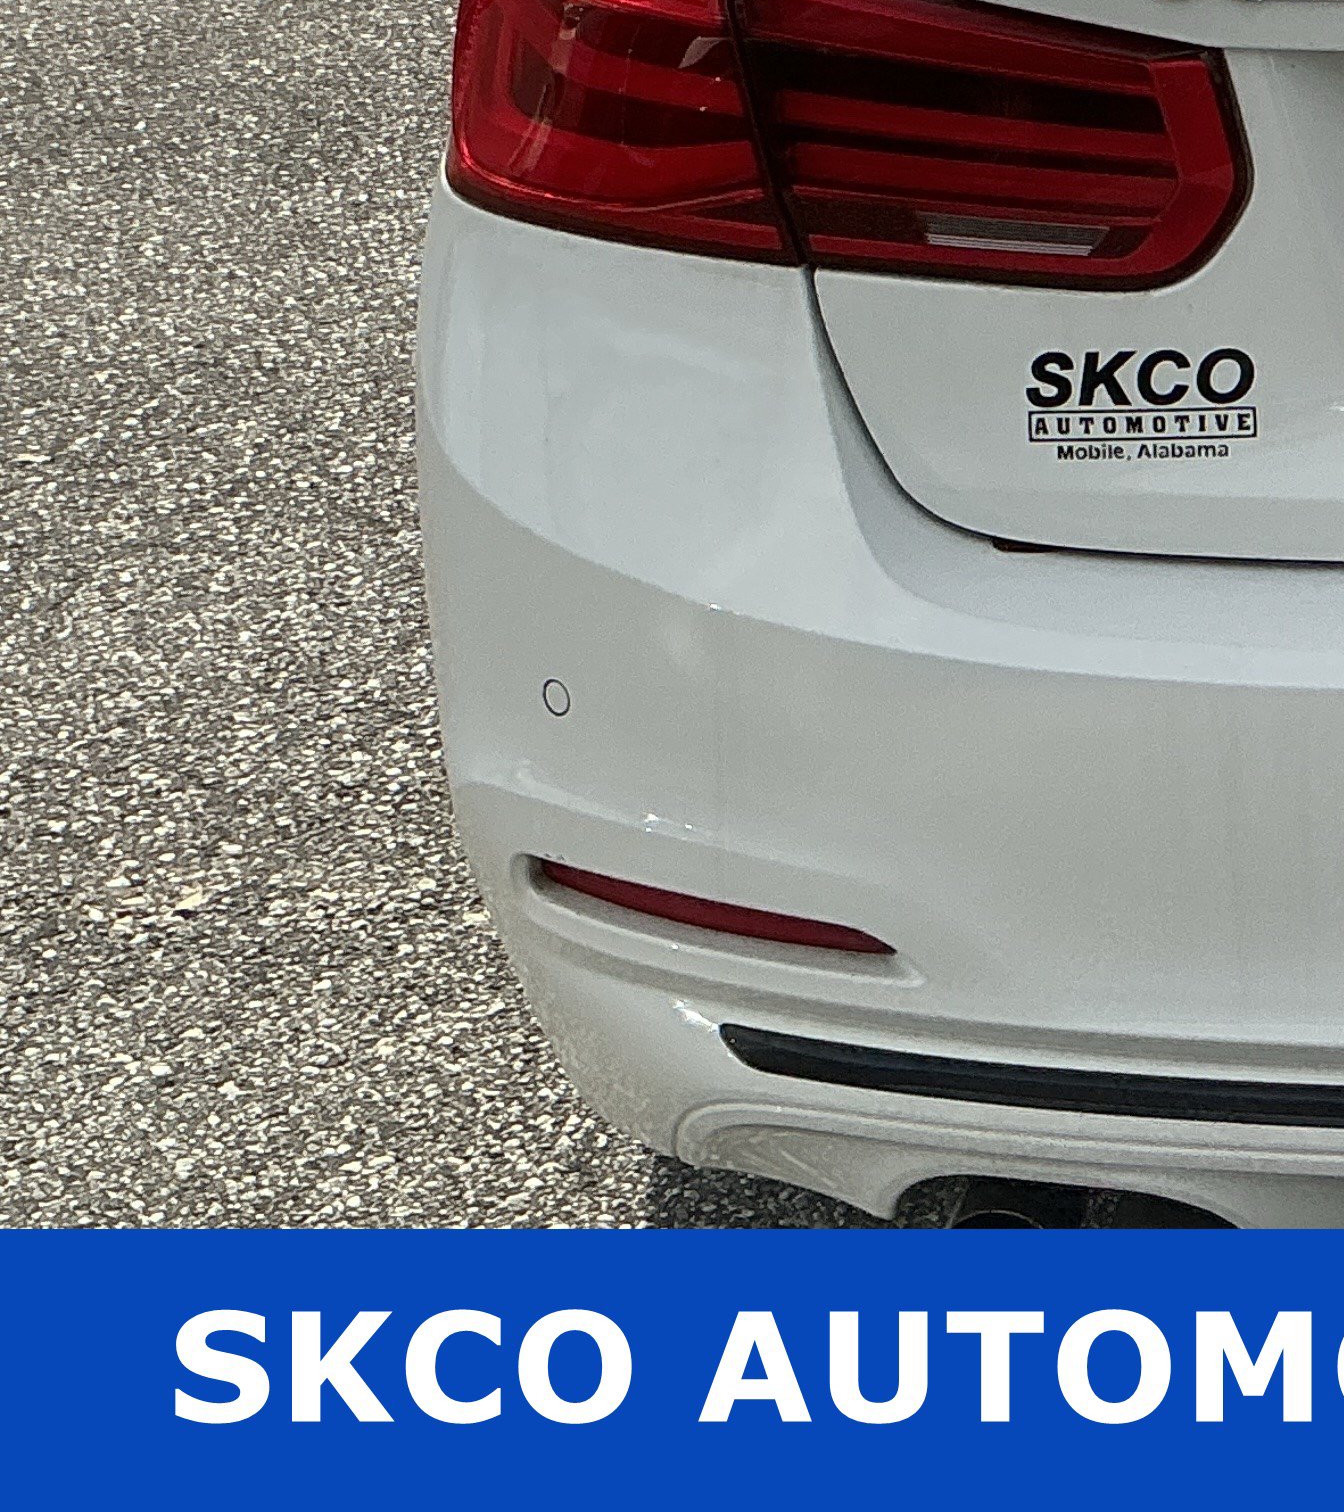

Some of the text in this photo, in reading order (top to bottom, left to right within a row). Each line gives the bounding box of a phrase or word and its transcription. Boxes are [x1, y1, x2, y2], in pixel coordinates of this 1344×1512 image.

[1026, 348, 1255, 408] SKCO
[1035, 413, 1250, 436] AUTOMOTIVE
[1057, 443, 1229, 461] Mobile, Alabama
